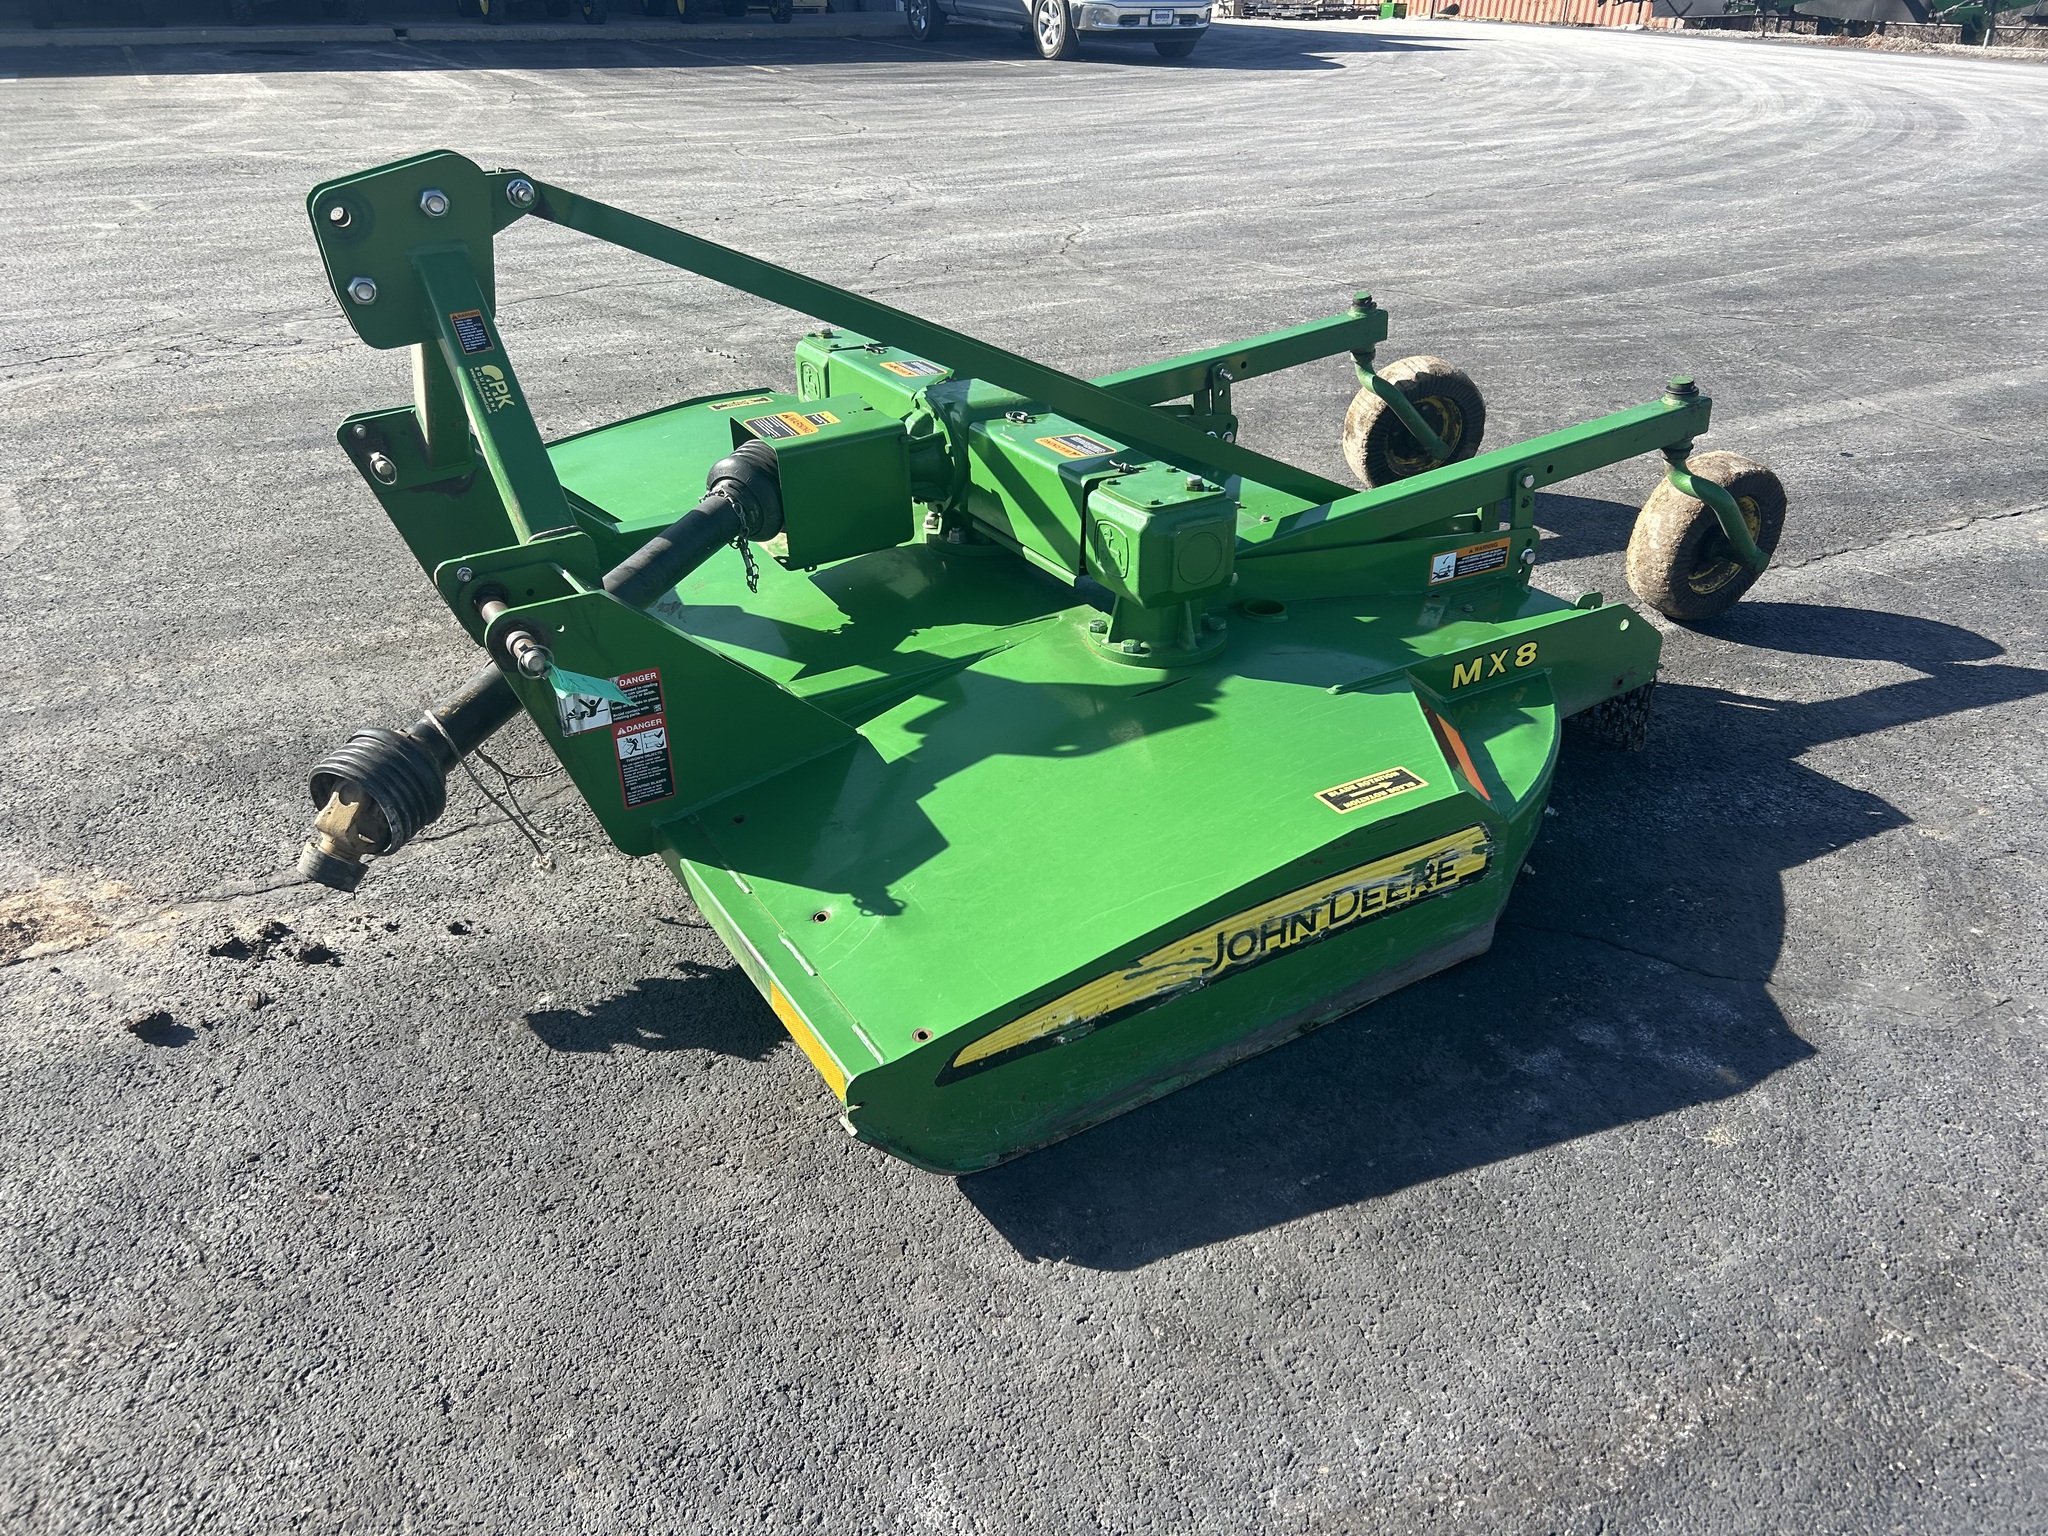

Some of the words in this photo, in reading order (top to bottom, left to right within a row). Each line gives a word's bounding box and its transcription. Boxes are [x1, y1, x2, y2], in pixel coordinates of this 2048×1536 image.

[474, 367, 498, 412] EQUIPMENT
[1474, 542, 1498, 552] WARNING
[619, 672, 657, 686] DANGER
[626, 718, 662, 732] DANGER
[1327, 783, 1358, 797] BLADE
[1358, 771, 1400, 788] ROTATION
[1388, 781, 1416, 794] BLADE
[1342, 789, 1388, 808] ROTATION
[1199, 905, 1320, 975] JOHN
[1328, 852, 1461, 924] DEERE
